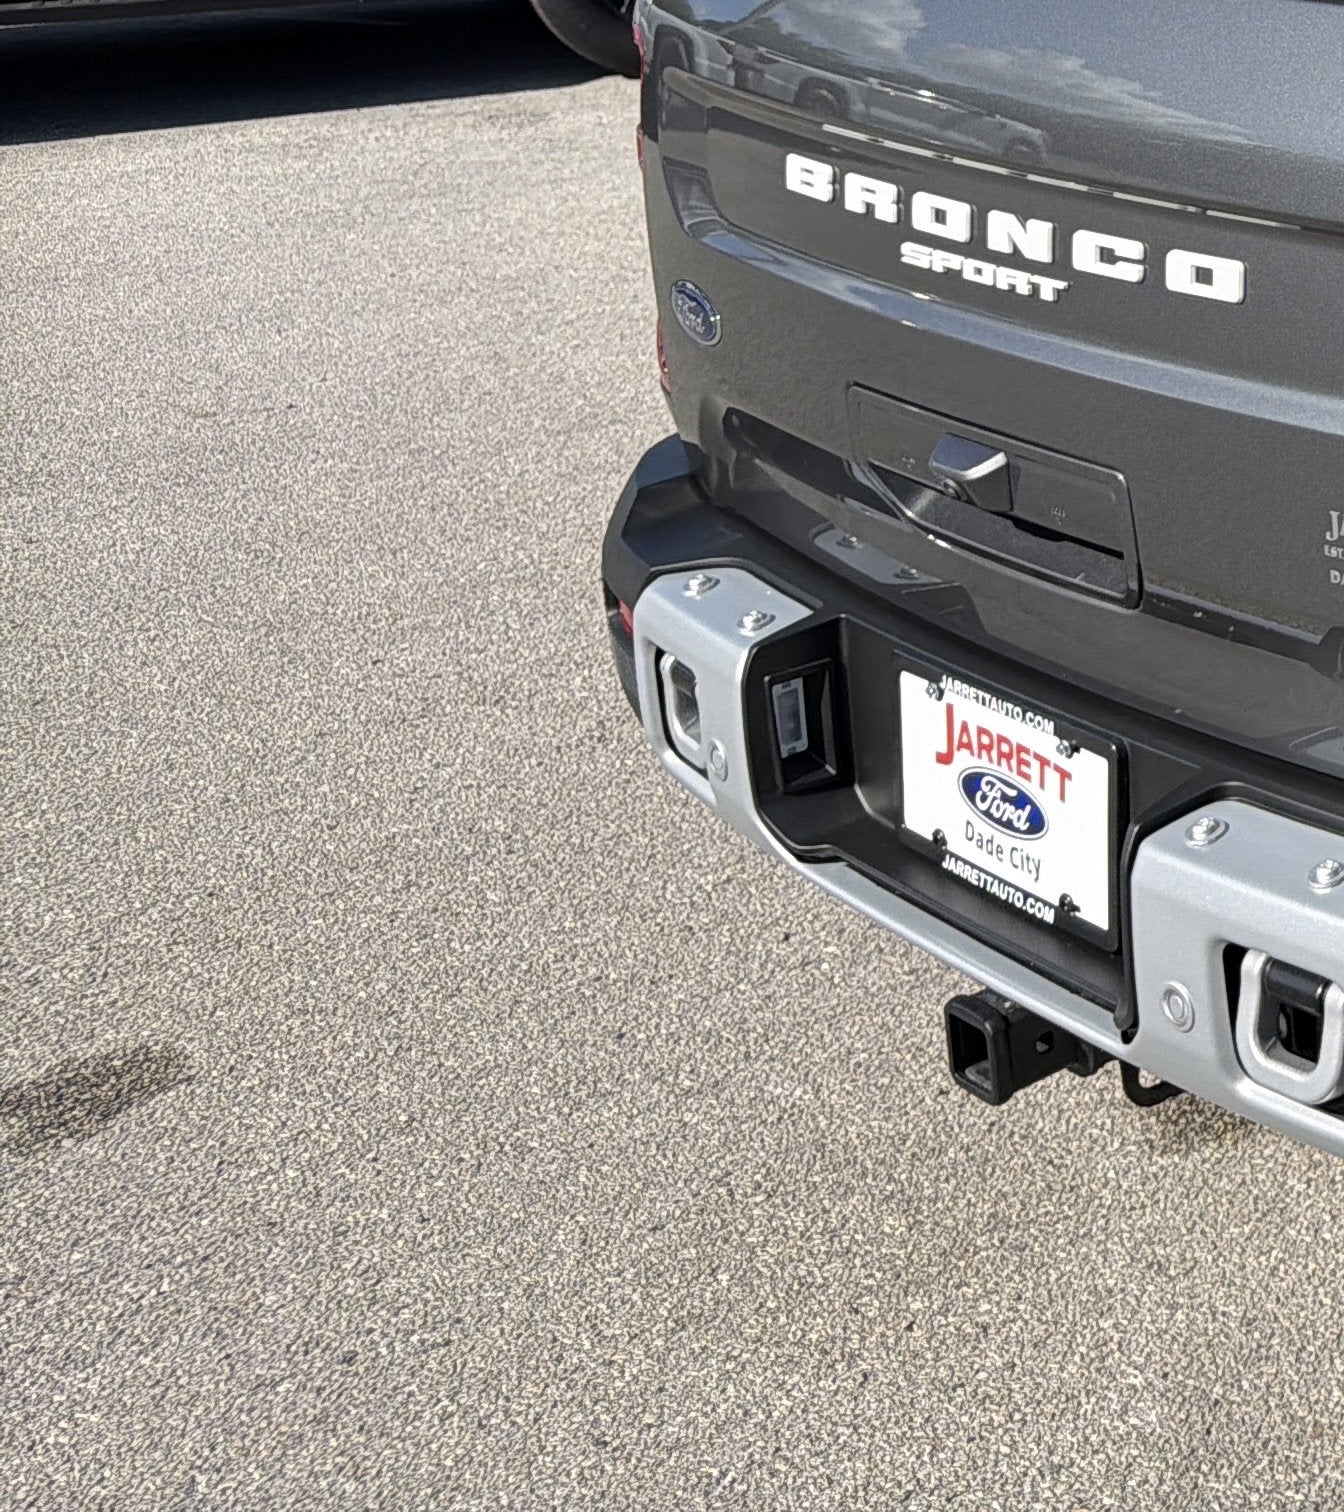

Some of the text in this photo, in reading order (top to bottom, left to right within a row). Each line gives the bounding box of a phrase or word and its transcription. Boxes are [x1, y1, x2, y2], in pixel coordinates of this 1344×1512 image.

[785, 153, 1247, 304] BRONCO
[900, 241, 1071, 302] SPORT
[677, 294, 705, 334] Ford
[939, 674, 1055, 736] JARRETTAUTO.COM
[935, 702, 1073, 804] JARRETT
[975, 775, 1032, 831] Ford
[964, 819, 1042, 883] Dade City
[941, 854, 1055, 924] JARRETTAUTO.COM
